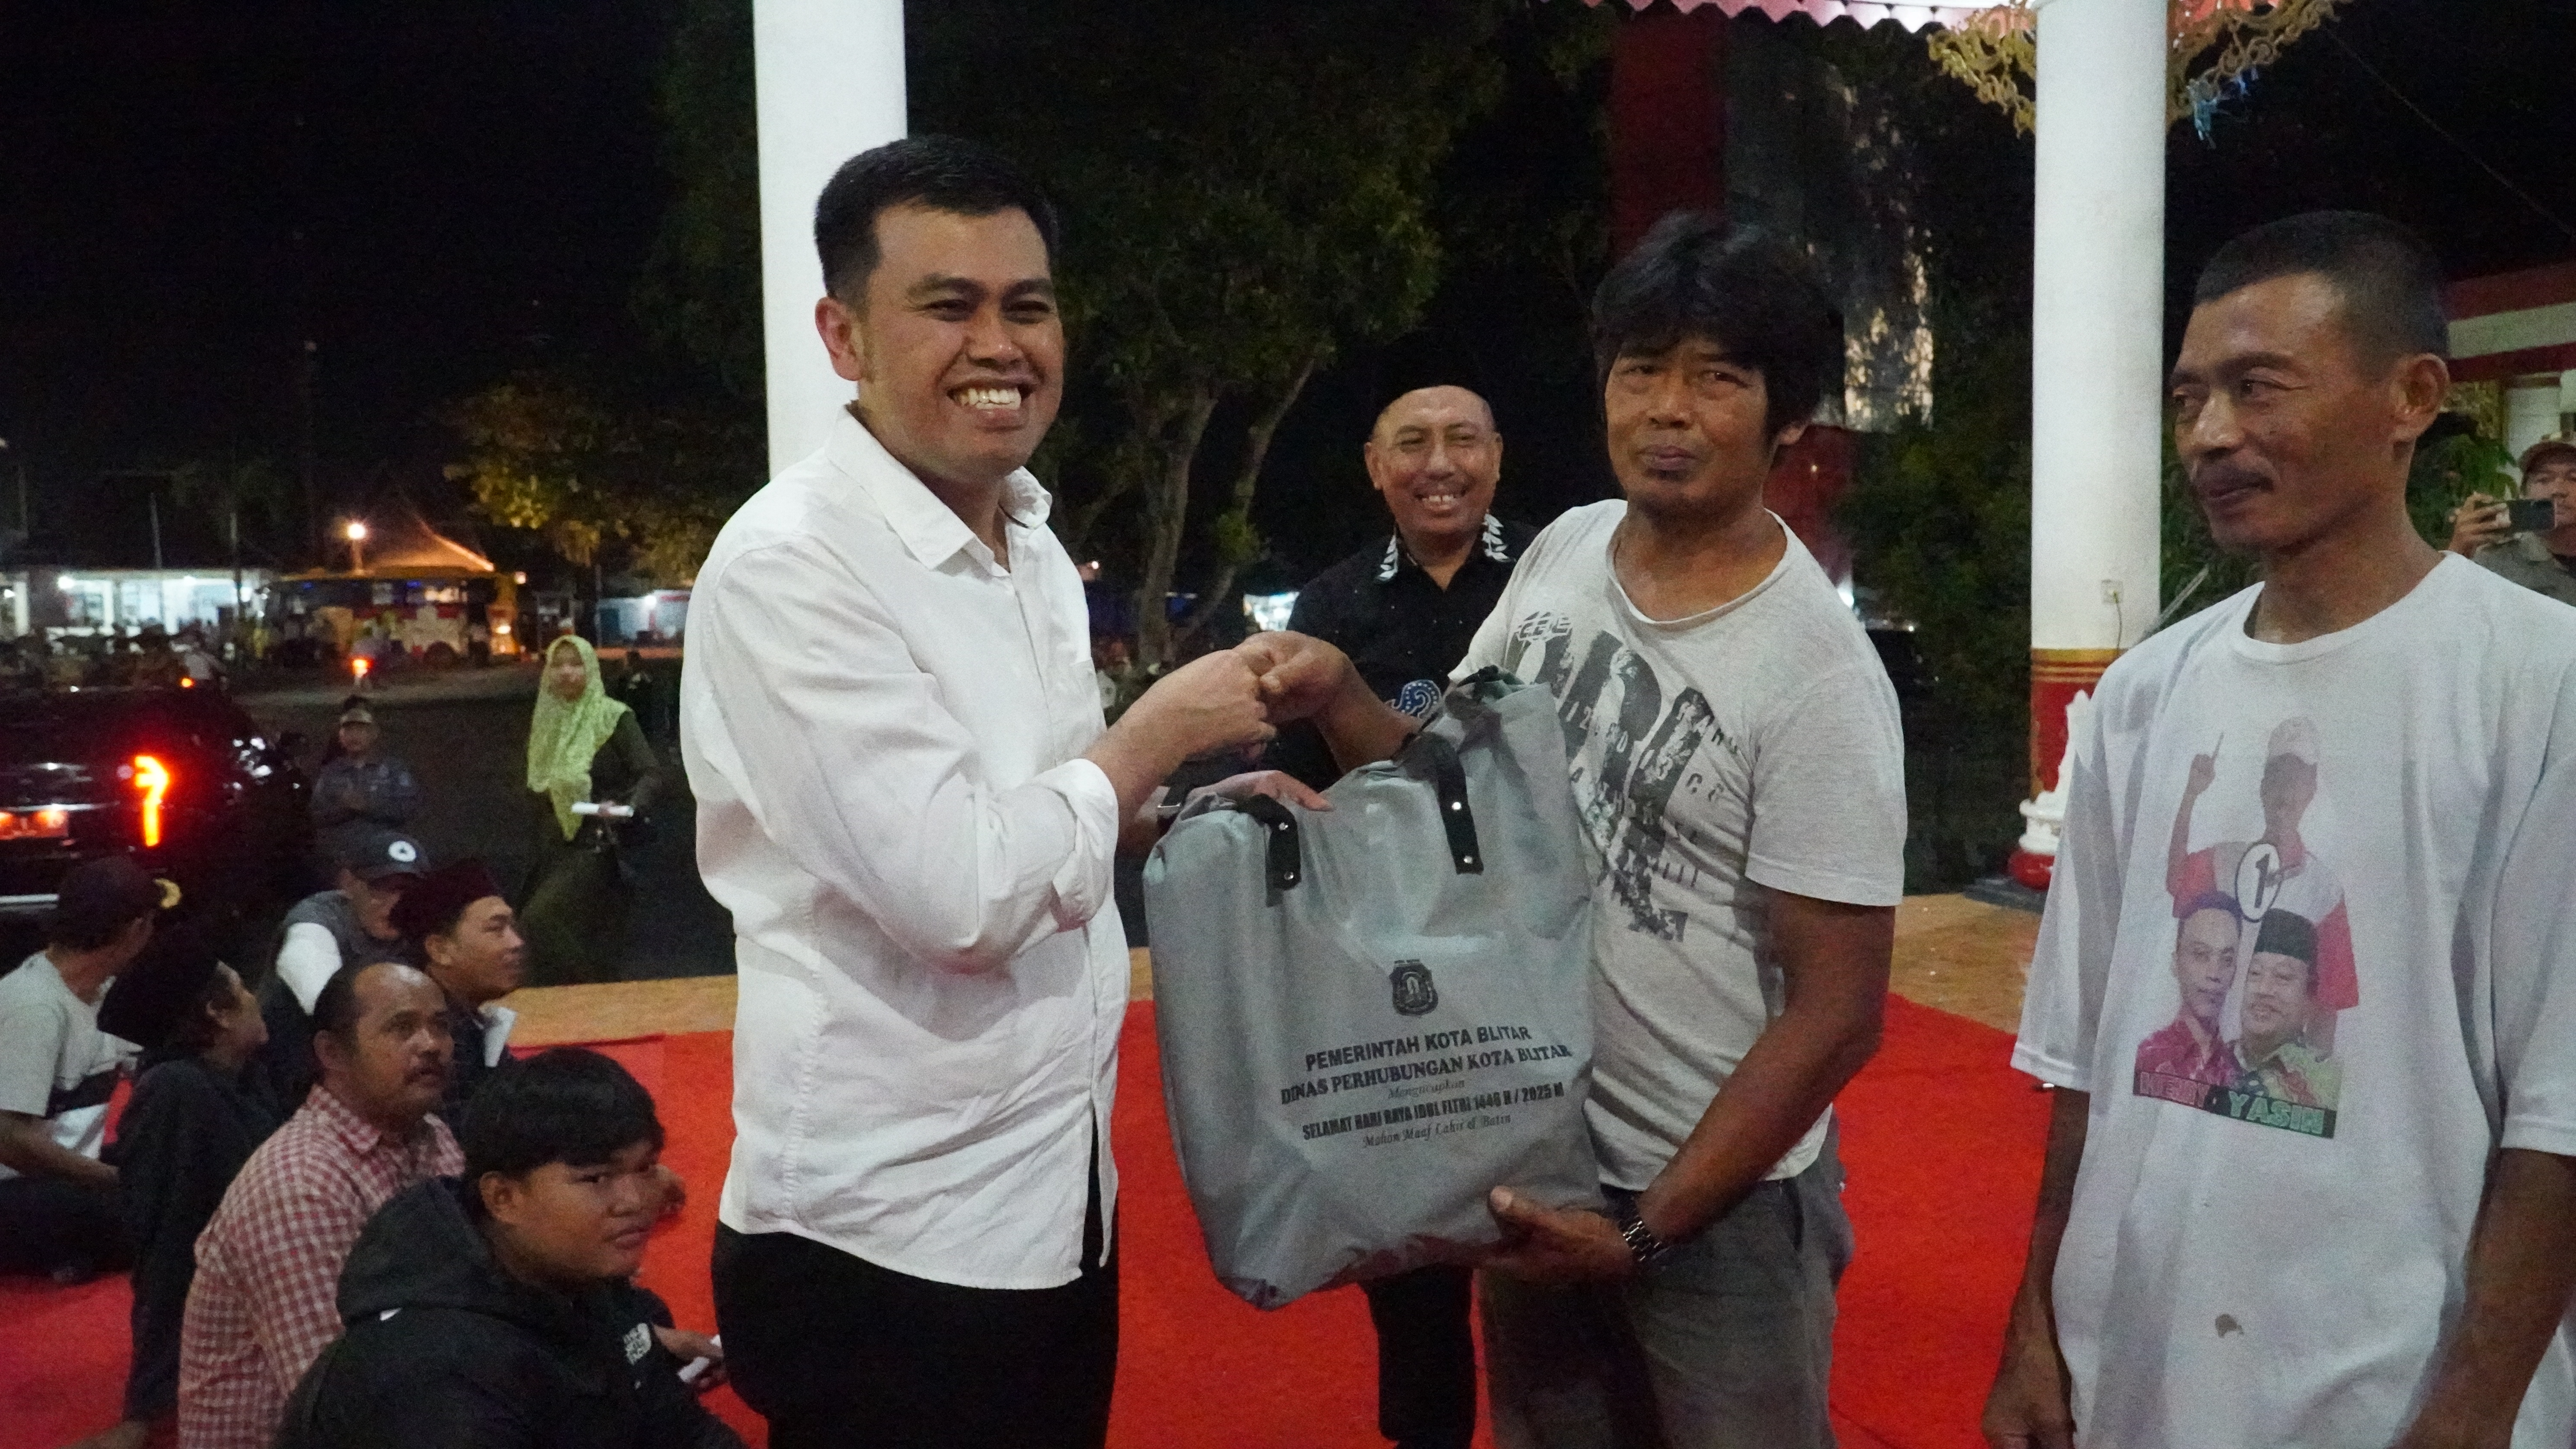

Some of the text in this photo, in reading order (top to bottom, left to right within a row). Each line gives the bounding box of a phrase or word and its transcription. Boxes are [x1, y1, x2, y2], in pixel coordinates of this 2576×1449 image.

[1306, 1025, 1532, 1071] PEMERINTAH KOTA BLITAR
[1280, 1043, 1573, 1105] DINAS PERHUBUNGAN KOTA BLITAR
[1302, 1116, 1353, 1140] SELAMAT
[1522, 1083, 1552, 1103] 2025
[2228, 1090, 2325, 1134] YASIN
